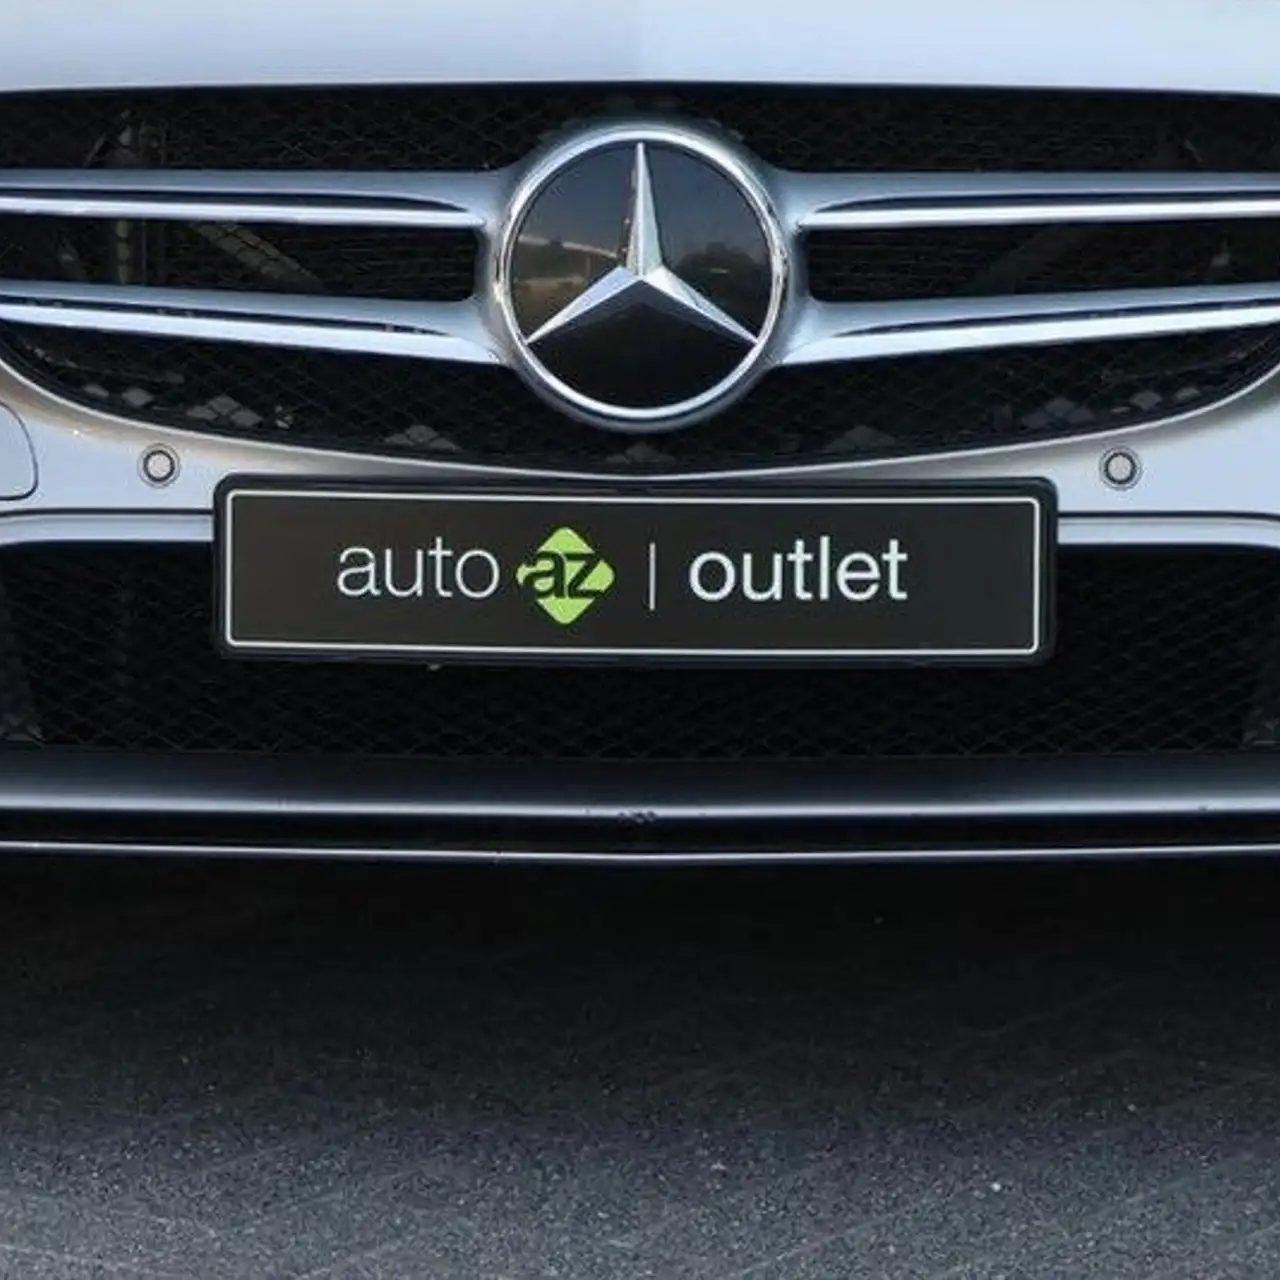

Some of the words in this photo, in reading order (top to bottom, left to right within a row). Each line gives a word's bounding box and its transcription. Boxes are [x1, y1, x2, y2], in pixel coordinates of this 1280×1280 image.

[336, 536, 500, 600] auto
[520, 551, 607, 600] az
[688, 535, 909, 602] outlet
